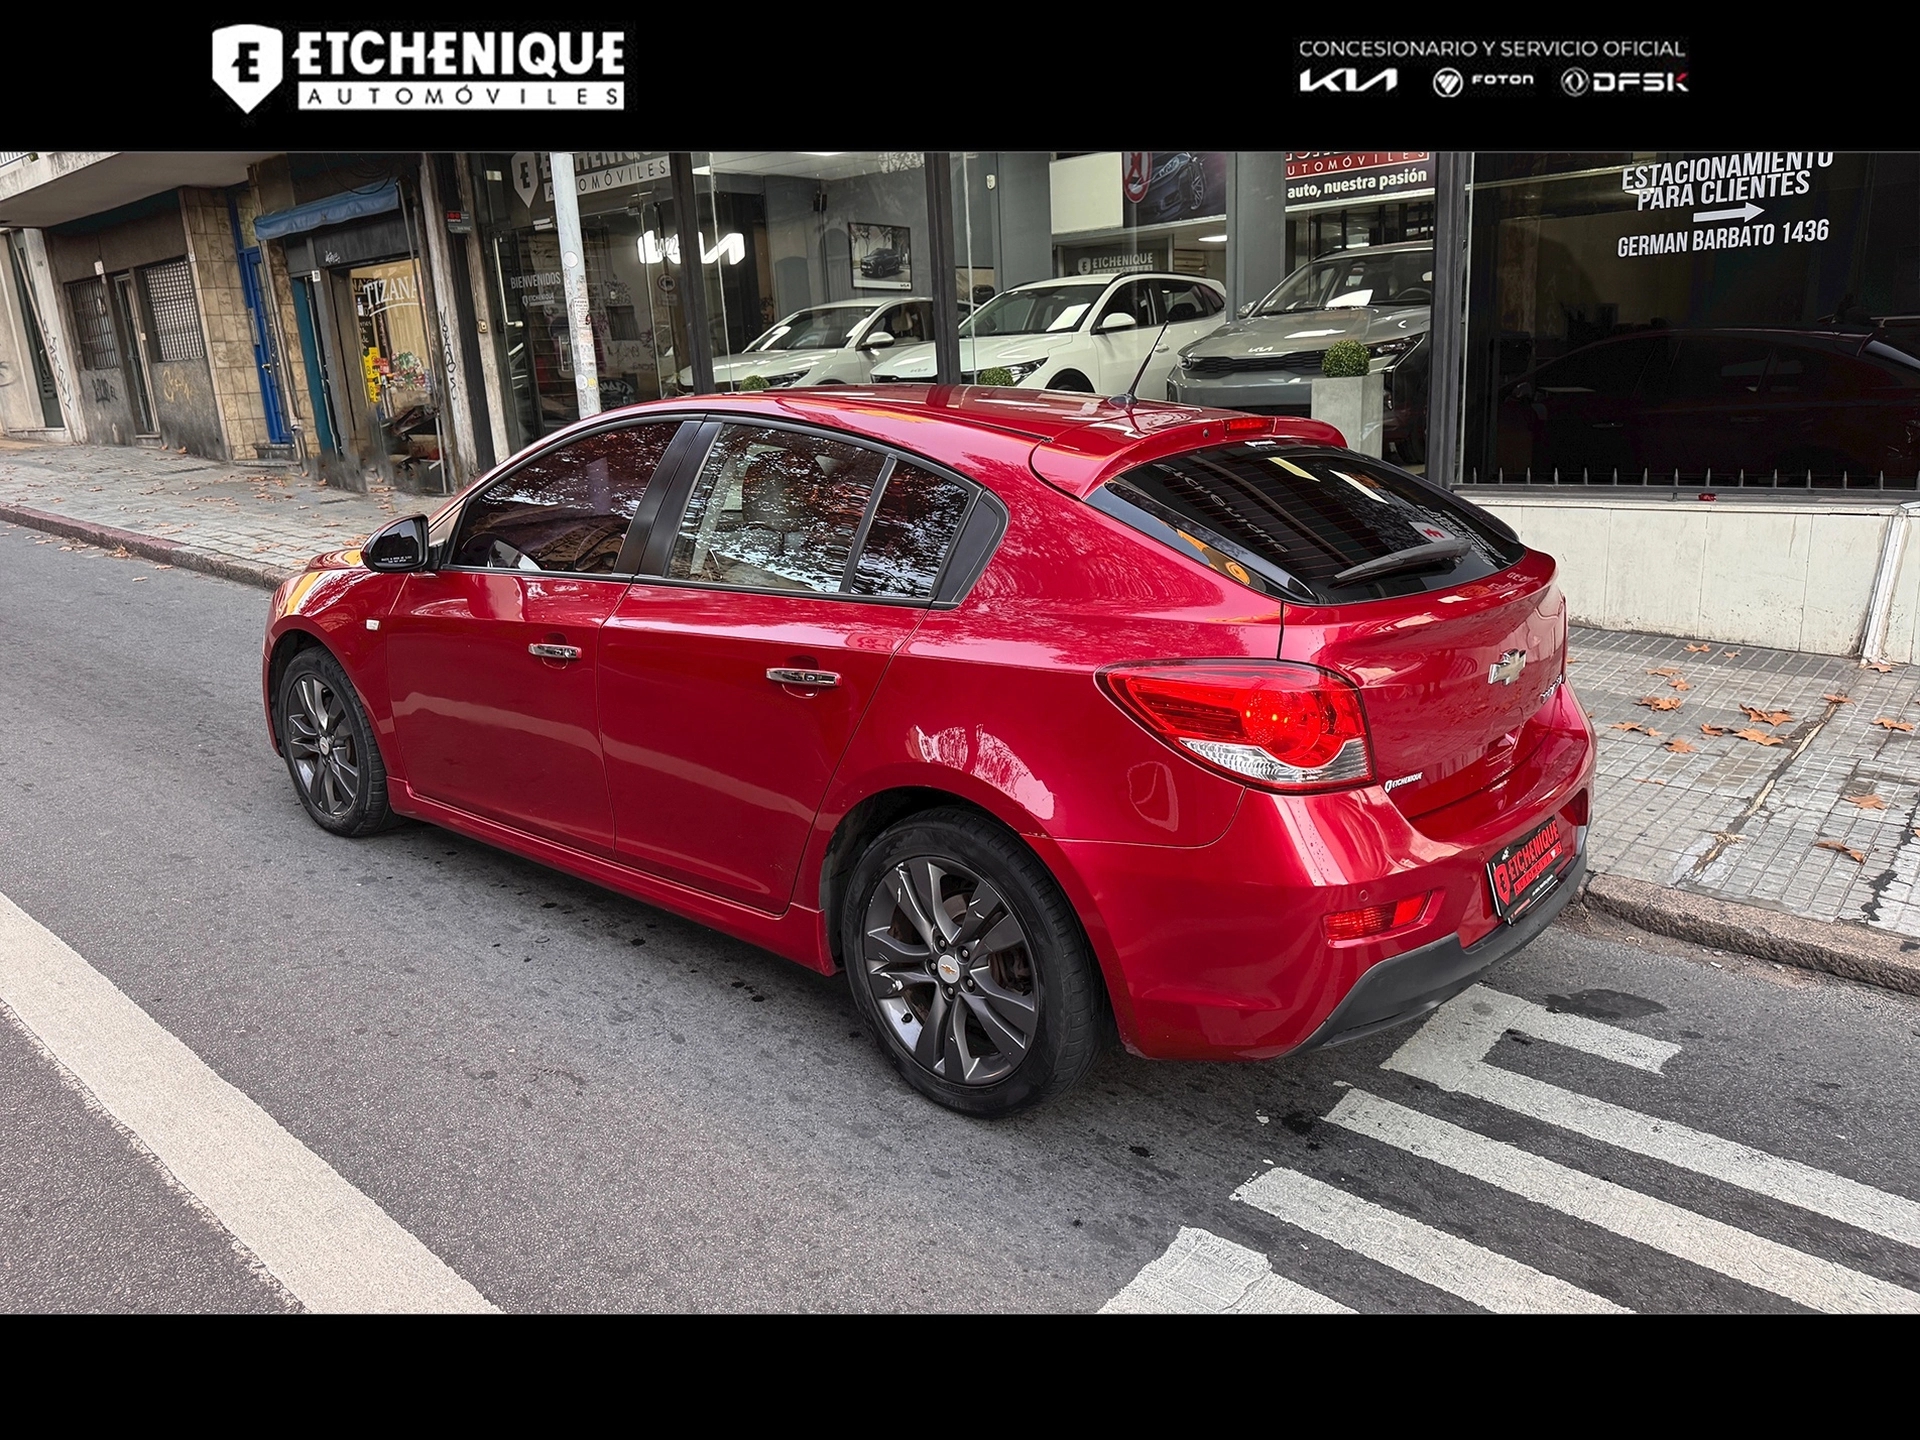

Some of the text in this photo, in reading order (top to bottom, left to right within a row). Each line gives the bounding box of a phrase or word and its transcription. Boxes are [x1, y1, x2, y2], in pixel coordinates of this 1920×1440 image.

[547, 160, 667, 197] AOMÓVILES
[1287, 152, 1425, 176] UTOMÓVILES
[1622, 152, 1834, 190] ESTACIONAMIENTO
[1287, 168, 1427, 199] auto, nuestra pasión
[1637, 170, 1811, 211] PARA CLIENTES
[1617, 218, 1830, 258] GERMAN BARBATO 1436
[1092, 252, 1154, 269] ETCHENIQUE
[510, 271, 562, 290] BIENVENIDOS
[1508, 819, 1560, 881] ETCHENIQUE
